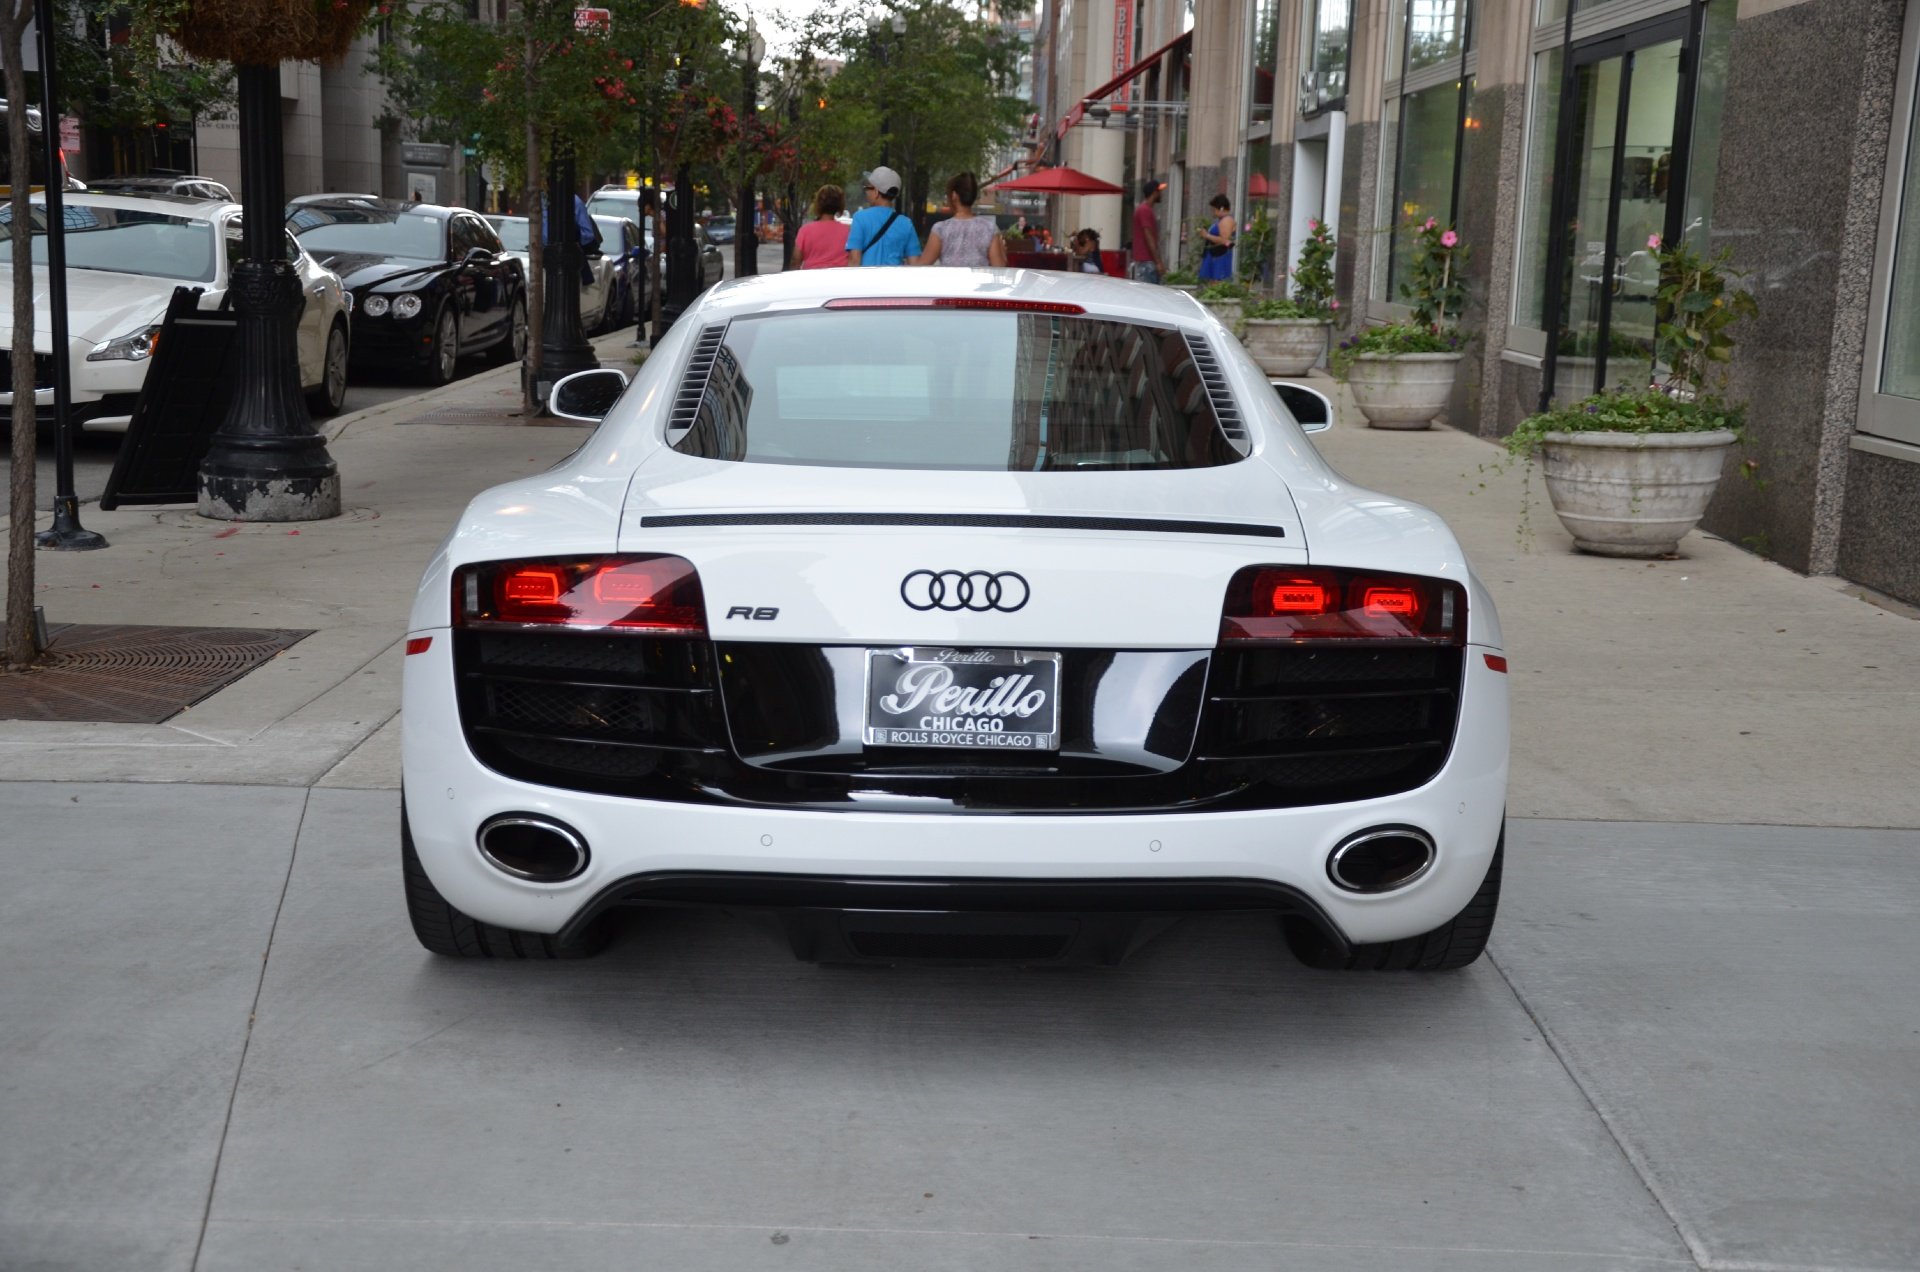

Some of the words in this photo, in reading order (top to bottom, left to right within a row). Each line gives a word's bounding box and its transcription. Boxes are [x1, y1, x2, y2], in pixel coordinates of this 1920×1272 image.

[726, 606, 779, 620] R8
[934, 650, 995, 662] Perillo
[880, 664, 1046, 717] Perillo
[920, 716, 1003, 731] CHICAGO
[891, 731, 928, 743] ROLLS
[932, 733, 973, 745] ROYCE
[977, 735, 1031, 746] CHICAGO
